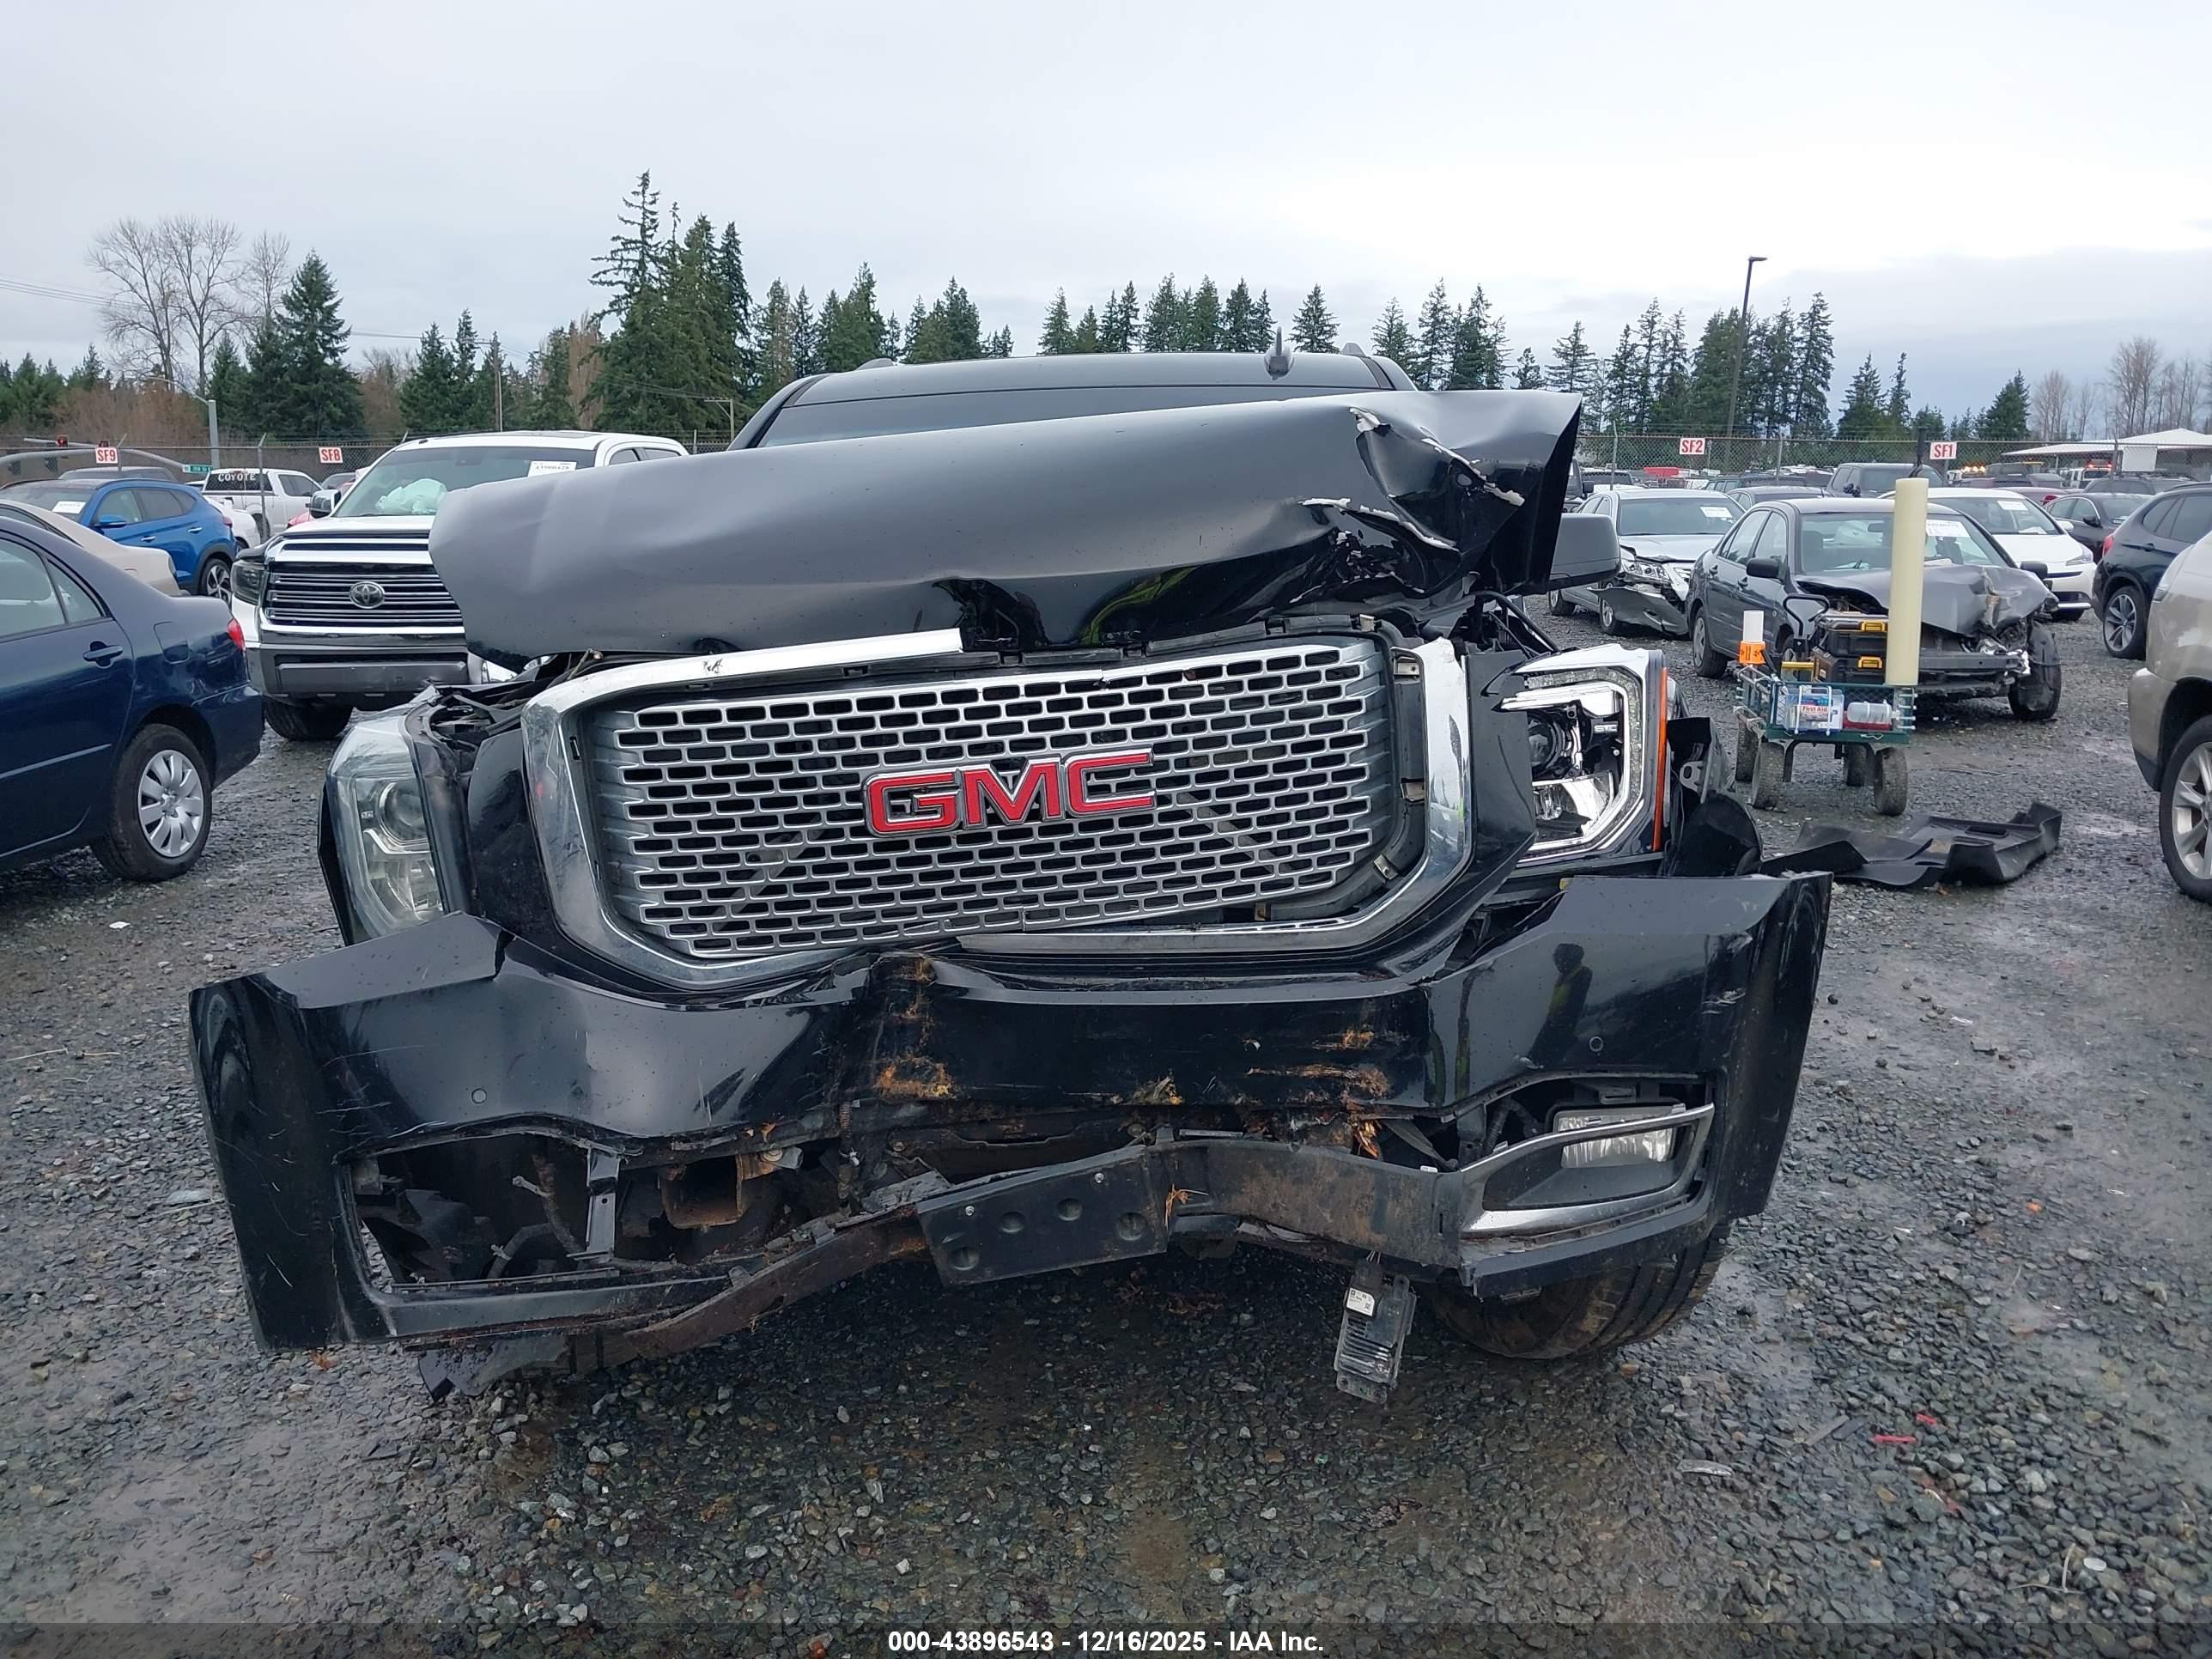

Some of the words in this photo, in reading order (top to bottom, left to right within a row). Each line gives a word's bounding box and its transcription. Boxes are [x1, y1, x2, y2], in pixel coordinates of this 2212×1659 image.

[1681, 440, 1703, 453] SF2
[1934, 444, 1953, 458] SF1
[97, 449, 116, 461] SF9
[321, 448, 341, 461] SF8
[218, 473, 256, 482] COYOTE
[864, 747, 1156, 837] GMC
